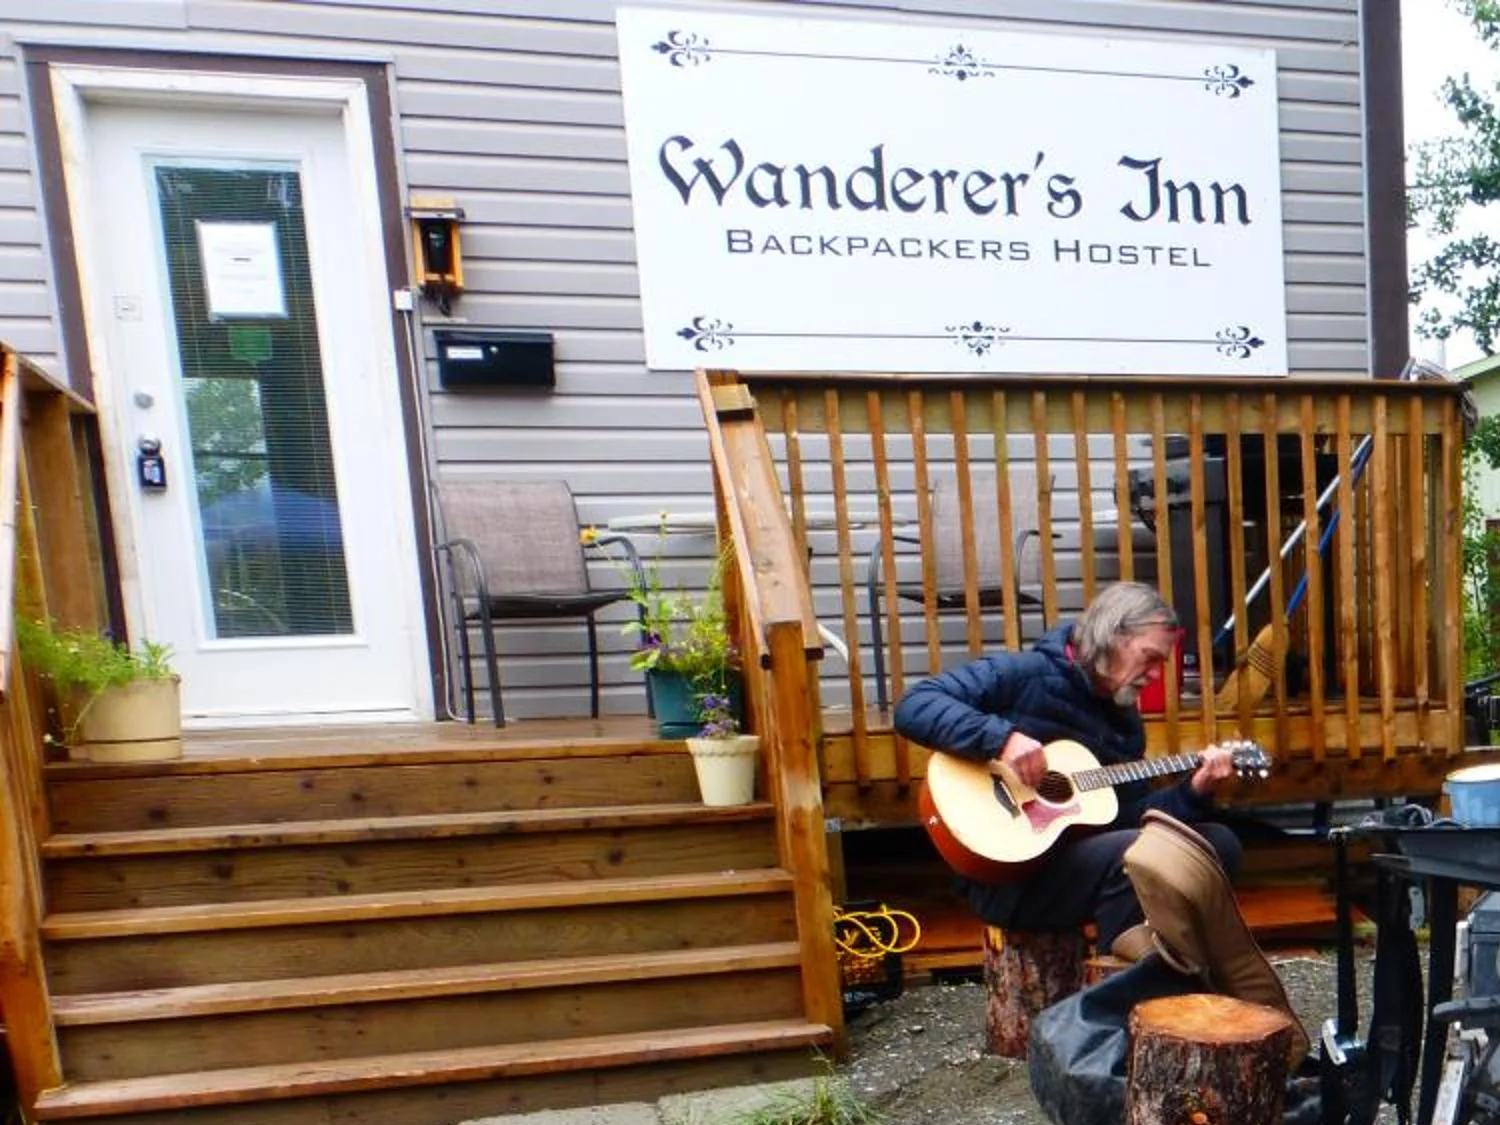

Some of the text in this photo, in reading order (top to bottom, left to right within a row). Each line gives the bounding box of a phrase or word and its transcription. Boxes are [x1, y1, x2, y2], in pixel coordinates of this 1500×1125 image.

[659, 135, 1252, 225] Wanderer's Inn
[726, 229, 1211, 267] BACKPACKERS HOSTEL
